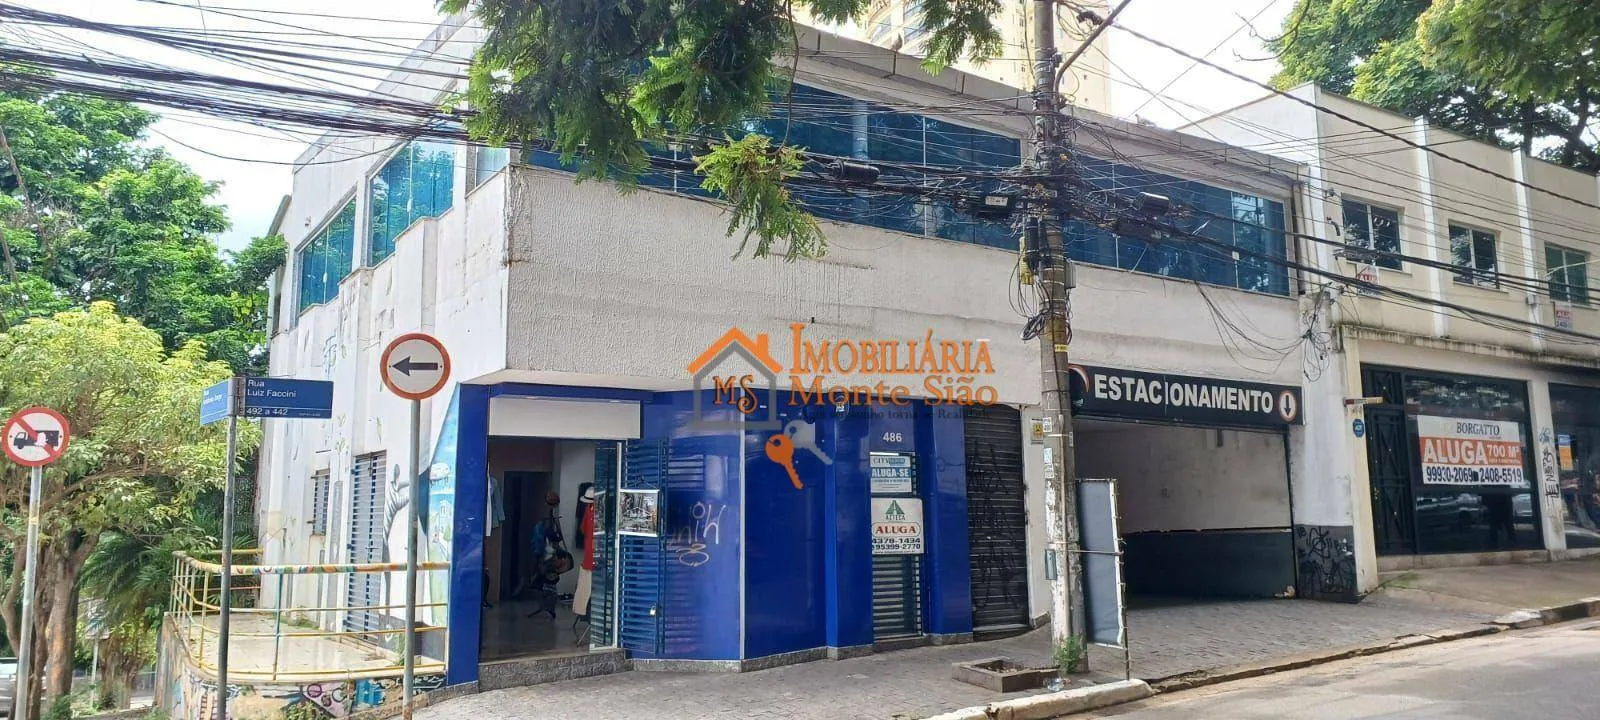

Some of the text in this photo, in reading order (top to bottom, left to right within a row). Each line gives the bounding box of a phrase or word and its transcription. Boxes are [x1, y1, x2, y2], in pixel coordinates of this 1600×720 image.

[247, 379, 265, 388] Rua
[247, 388, 297, 398] Luiz Faccini
[1094, 373, 1274, 414] ESTACIONAMENTO
[246, 407, 263, 416] 492
[272, 408, 289, 416] 442
[1456, 422, 1501, 436] BORGATTO
[882, 432, 903, 442] 486
[1423, 438, 1489, 465] ALUGA
[1486, 444, 1506, 458] 700
[871, 468, 910, 477] ALUGA-SE
[1479, 467, 1523, 483] 2408-5519
[875, 525, 917, 534] ALUGA
